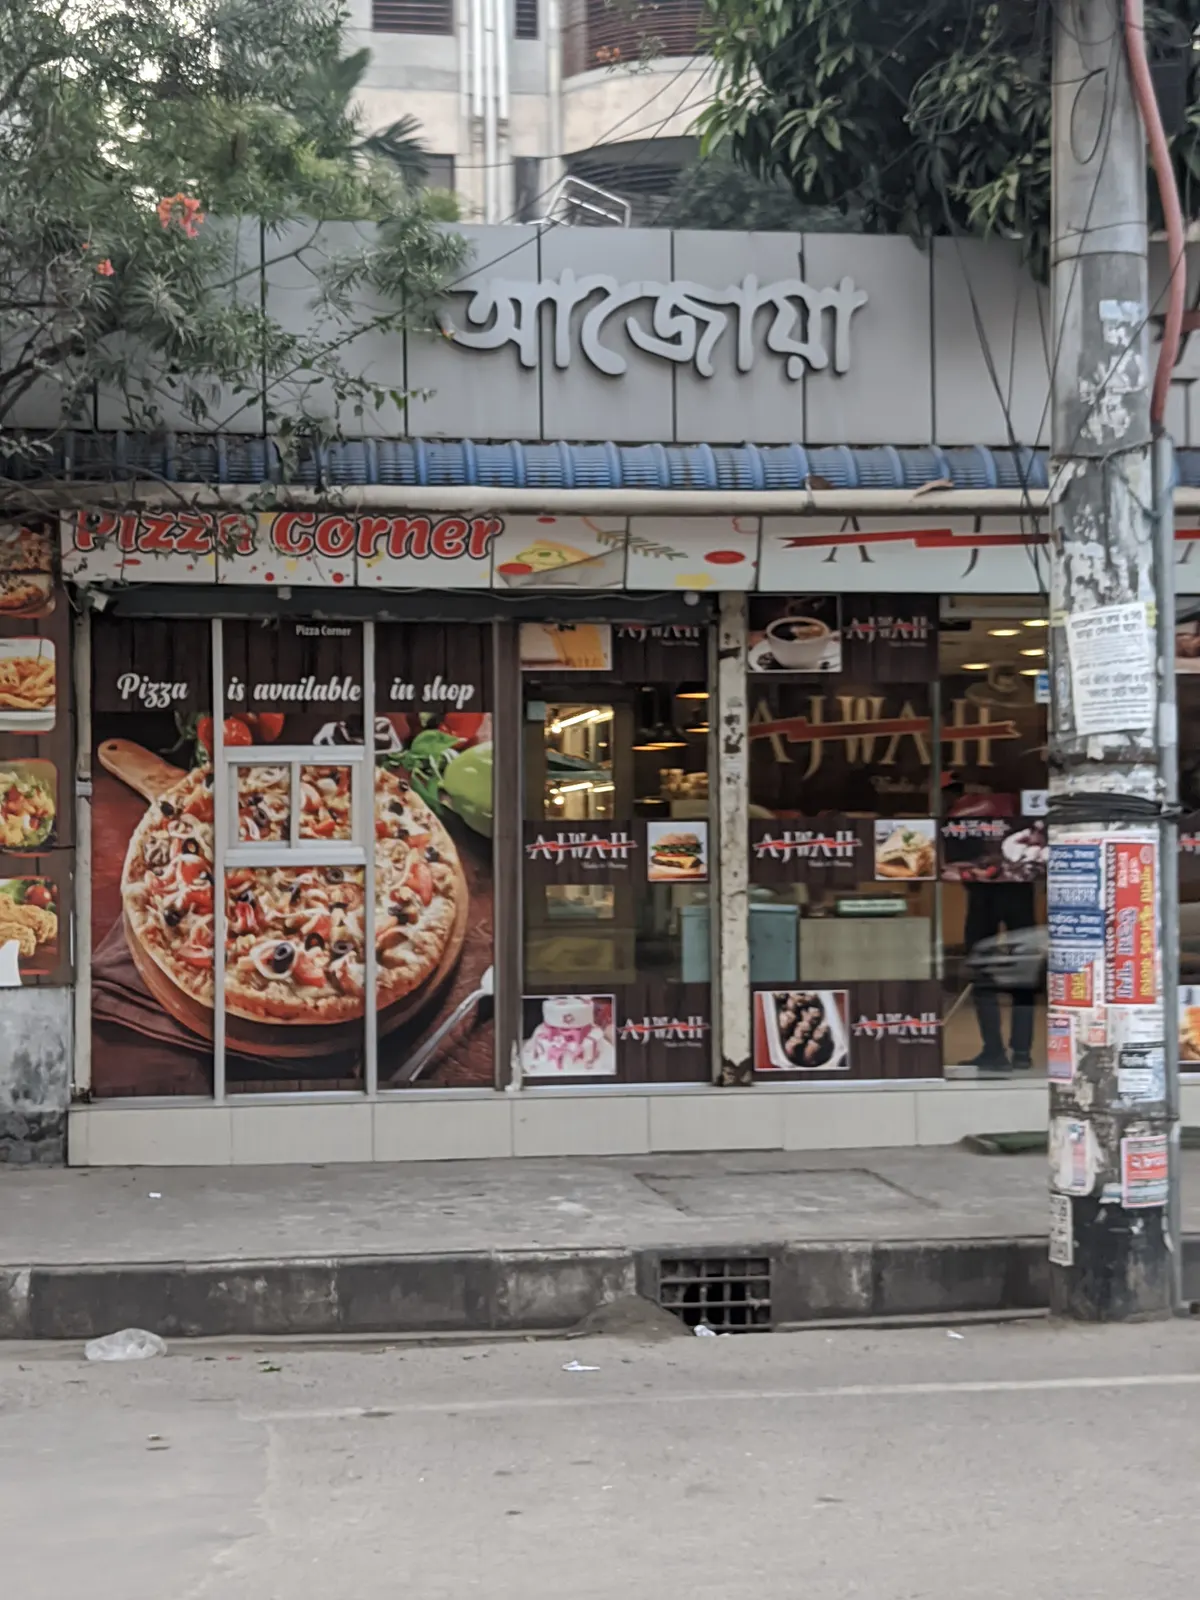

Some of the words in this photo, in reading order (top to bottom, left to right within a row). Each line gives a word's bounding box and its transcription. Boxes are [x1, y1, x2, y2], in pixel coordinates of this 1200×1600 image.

[443, 268, 868, 380] আজোয়া
[271, 511, 504, 560] Corner
[295, 624, 320, 636] Pizza
[321, 625, 352, 636] Corner
[116, 672, 189, 708] Pizza
[227, 676, 245, 701] is
[253, 676, 361, 702] available
[389, 677, 414, 701] in
[422, 675, 475, 710] shop
[747, 695, 996, 781] AJWAH
[528, 832, 629, 865] AJWAH
[755, 830, 855, 863] AJWAH
[620, 1015, 704, 1045] AJWAH
